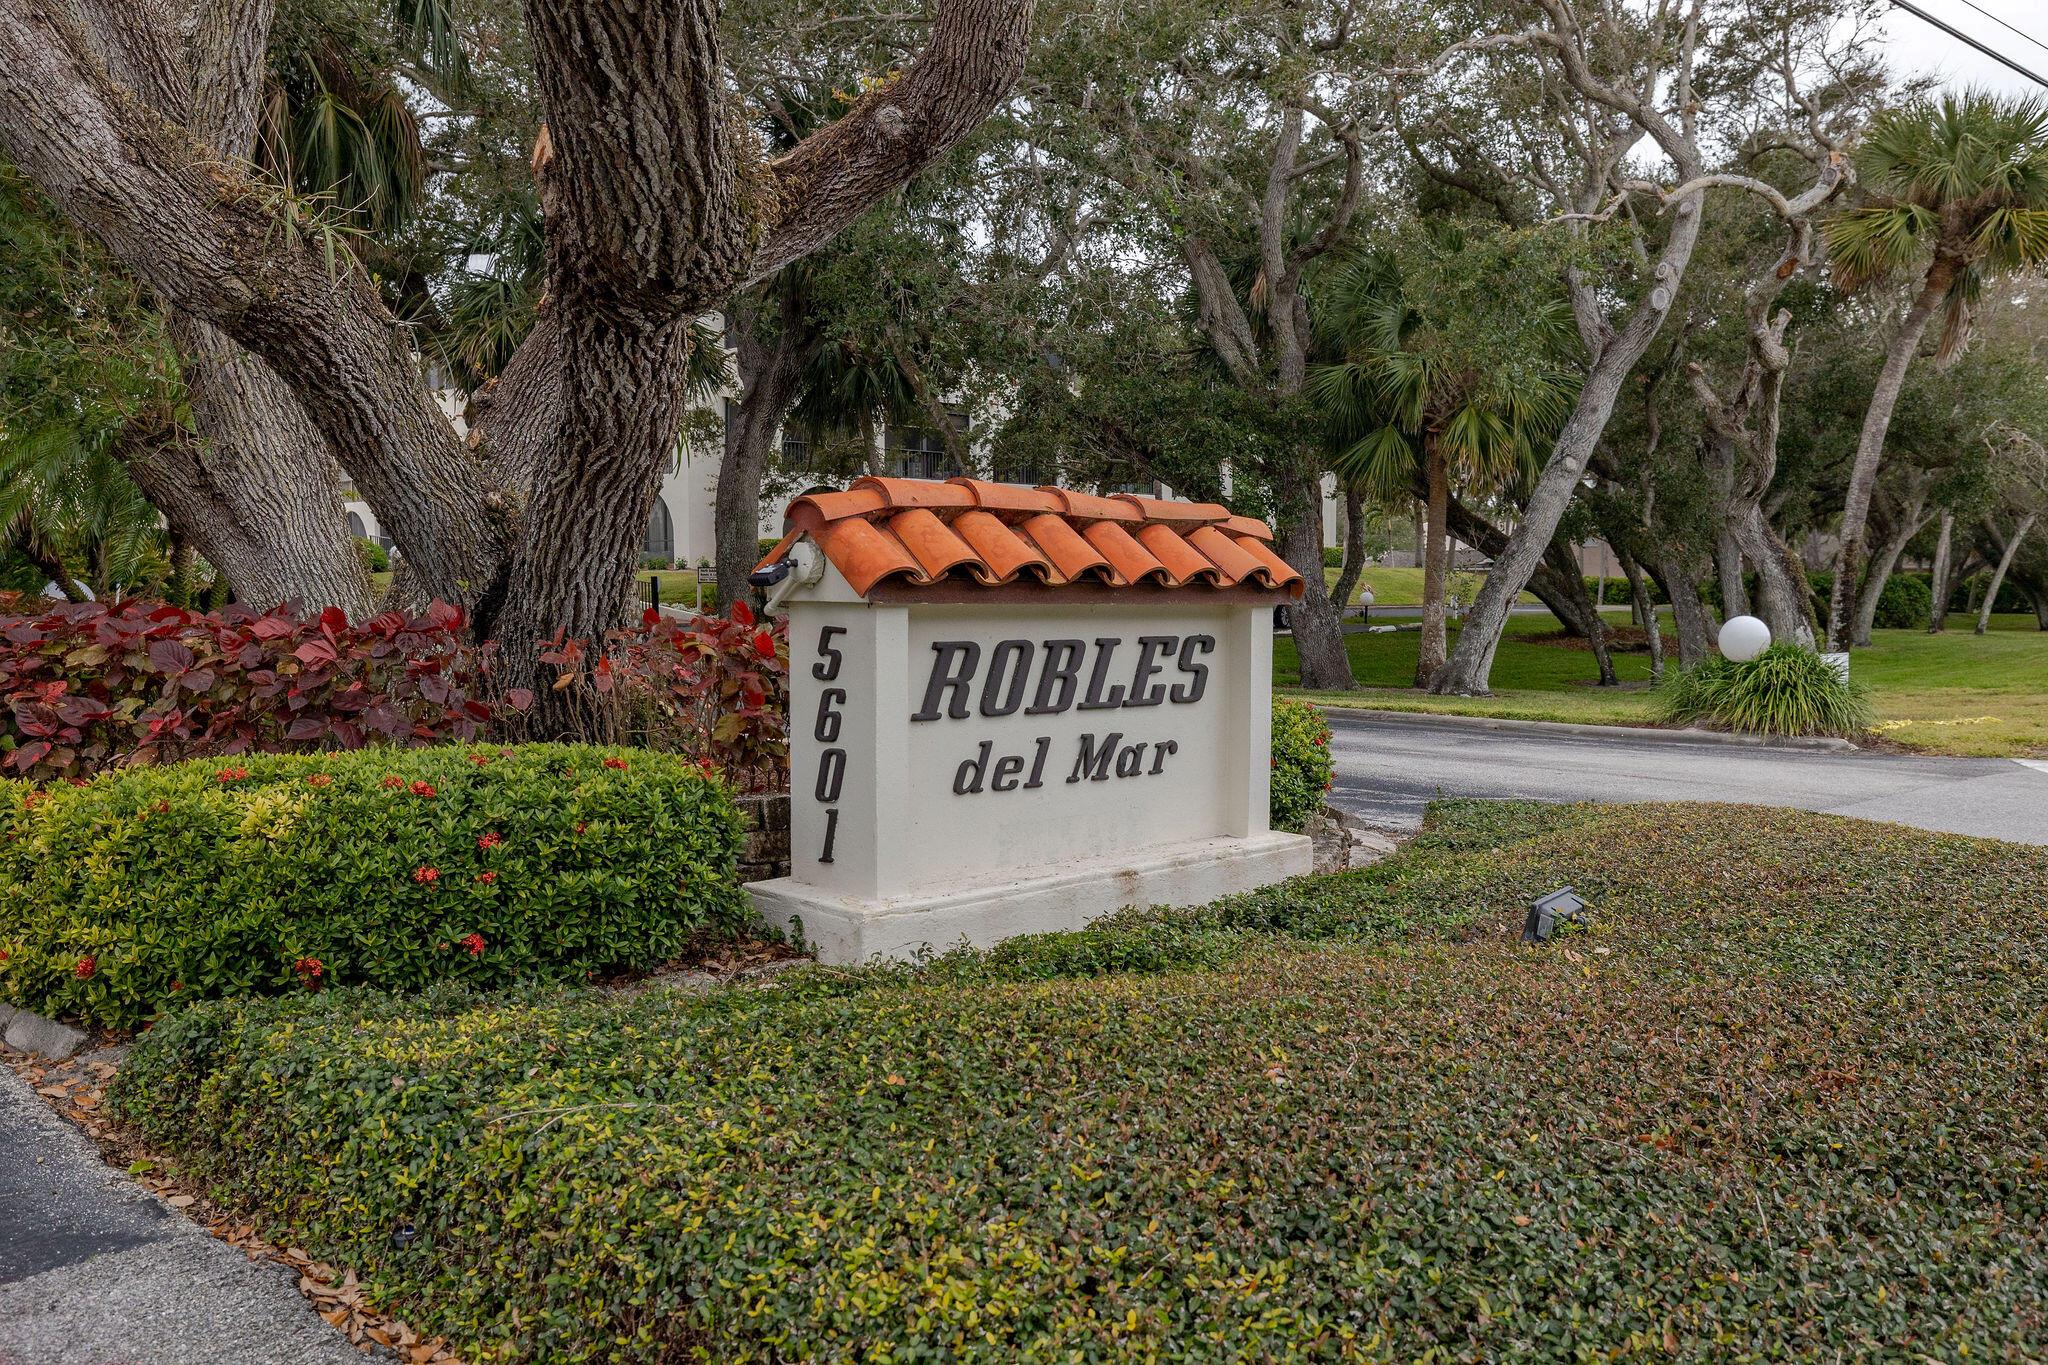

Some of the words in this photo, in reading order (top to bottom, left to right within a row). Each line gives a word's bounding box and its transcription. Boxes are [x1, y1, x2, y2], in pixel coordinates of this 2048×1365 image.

[911, 634, 1215, 723] ROBLES
[812, 625, 847, 864] 5601
[953, 737, 1052, 795] del
[1066, 733, 1178, 783] Mar
